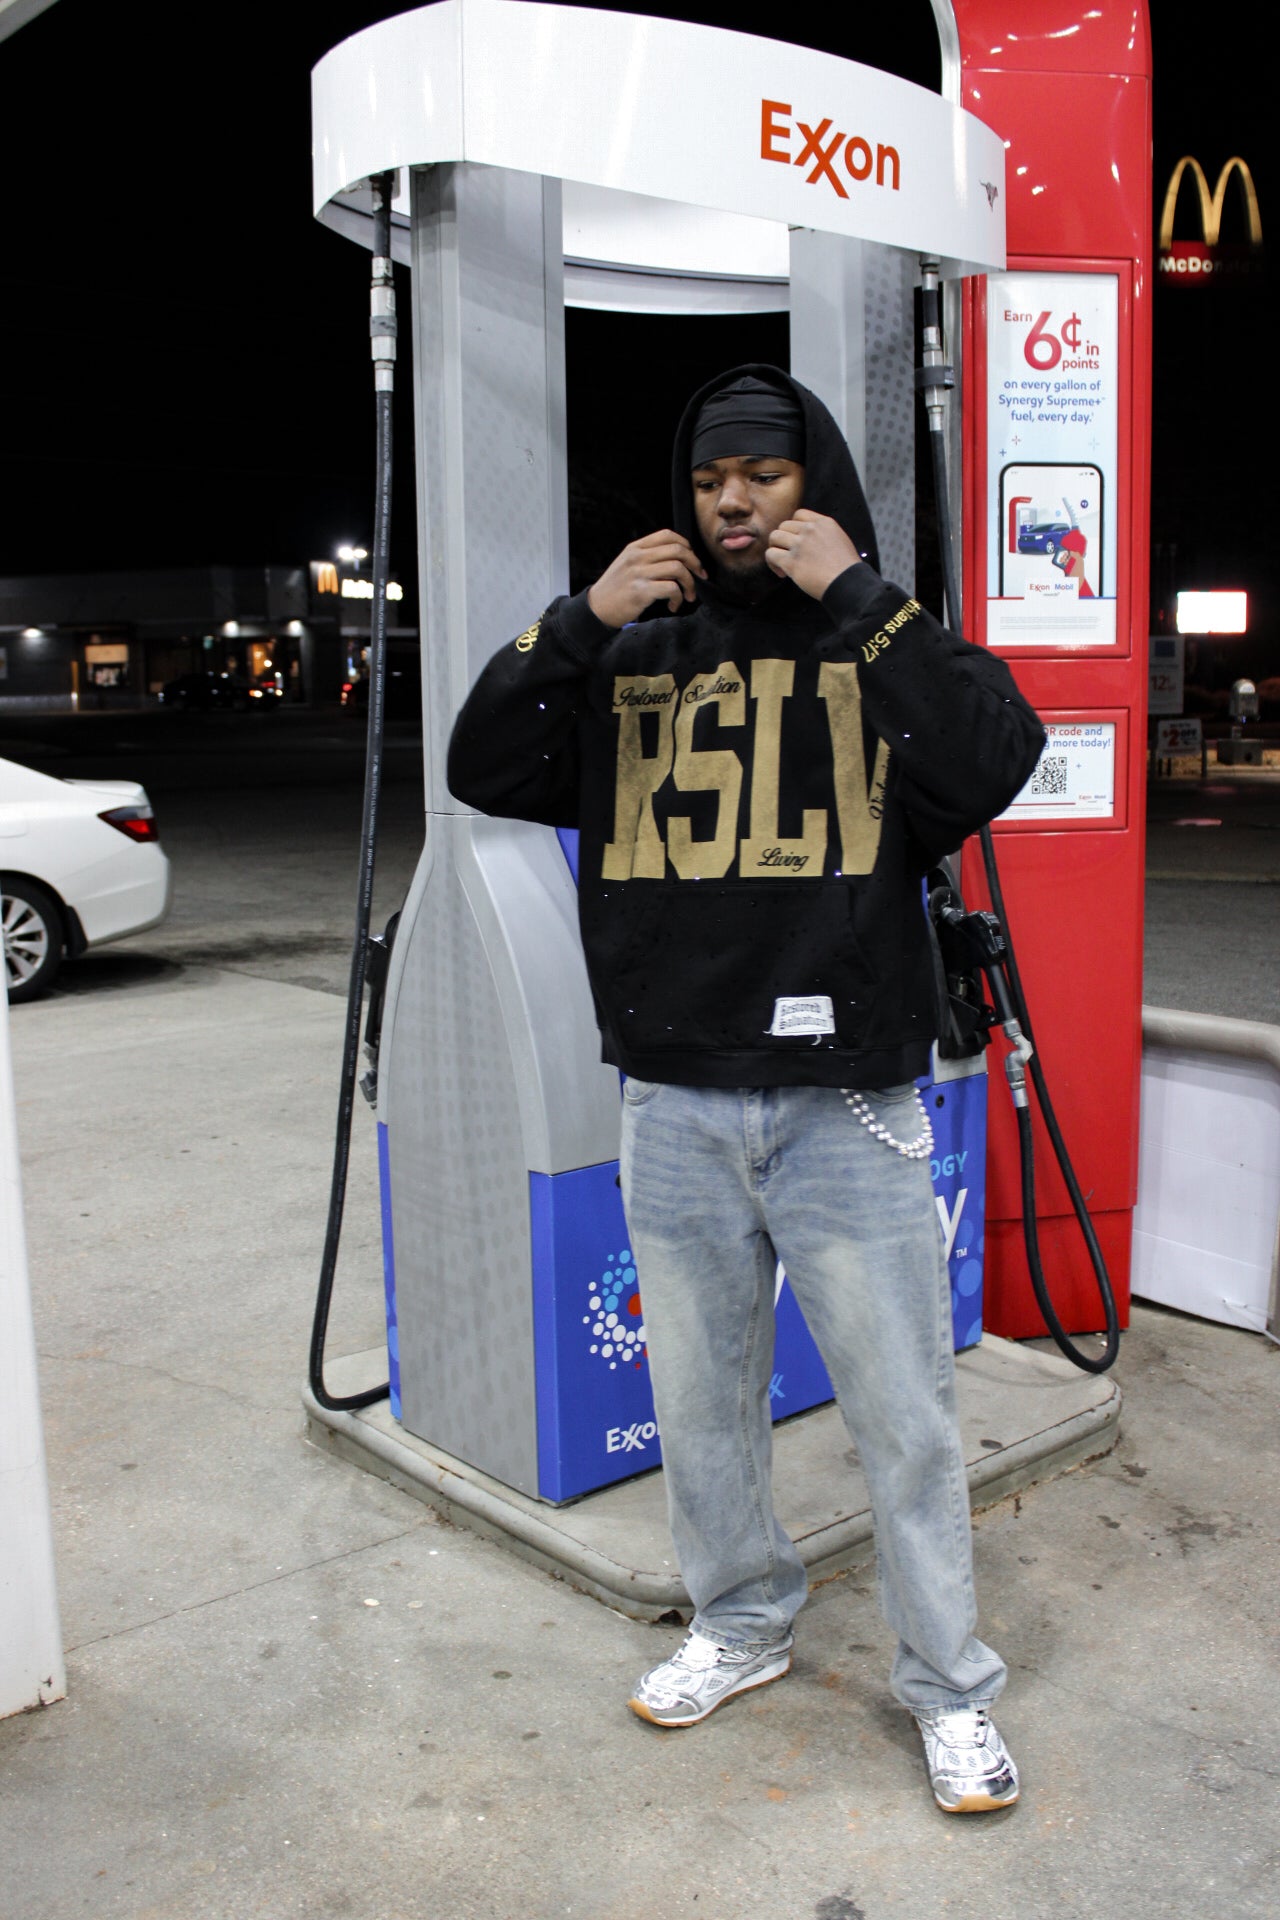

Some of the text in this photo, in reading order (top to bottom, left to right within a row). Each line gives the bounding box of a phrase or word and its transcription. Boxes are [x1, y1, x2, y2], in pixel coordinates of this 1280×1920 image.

[761, 98, 900, 200] Exxon
[1004, 310, 1033, 322] Earn
[1086, 340, 1100, 356] in
[1062, 357, 1100, 372] points
[1003, 379, 1102, 392] on every gallon of
[998, 394, 1044, 408] Synergy
[1010, 409, 1035, 422] fuel,
[1037, 412, 1068, 424] every
[861, 631, 891, 663] 5:17
[1059, 726, 1082, 736] code
[1085, 725, 1103, 736] and
[1081, 738, 1110, 750] today!
[602, 658, 891, 881] RSLV
[757, 848, 810, 872] Living
[930, 1151, 968, 1181] OGY
[606, 1421, 660, 1454] Exxo
